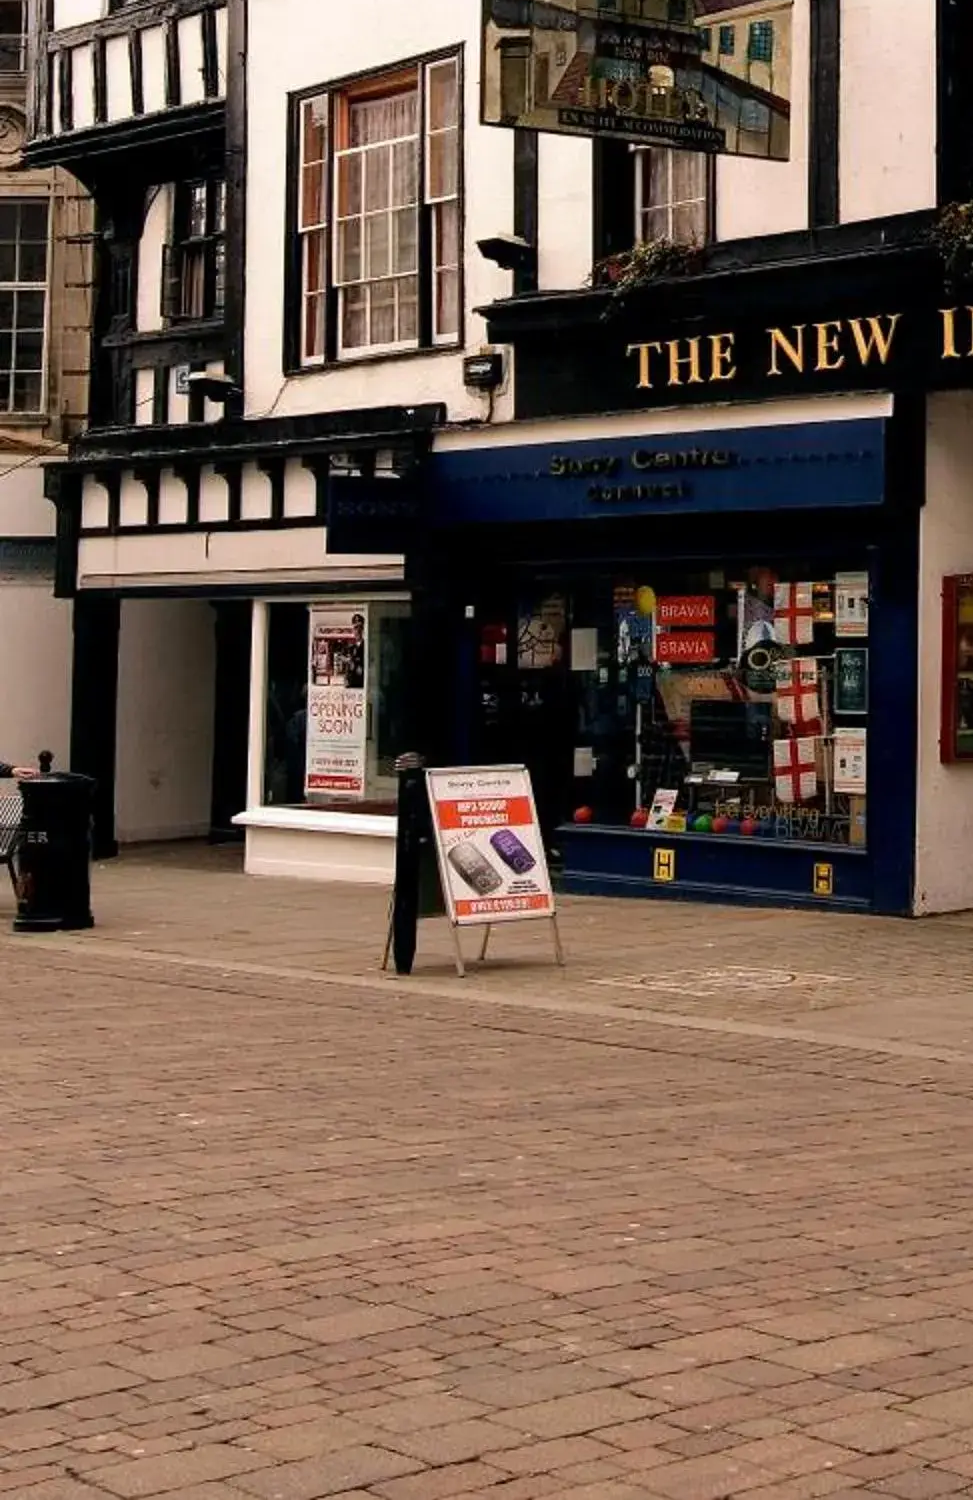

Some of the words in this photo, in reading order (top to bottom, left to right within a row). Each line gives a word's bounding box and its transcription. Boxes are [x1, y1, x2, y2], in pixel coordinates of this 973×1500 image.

[625, 332, 737, 389] THE
[766, 313, 903, 377] NEW
[630, 448, 730, 470] Centre
[661, 604, 709, 618] BRAVIA
[659, 640, 709, 655] BRAVIA
[311, 702, 363, 718] OPENING
[317, 719, 353, 734] SOON
